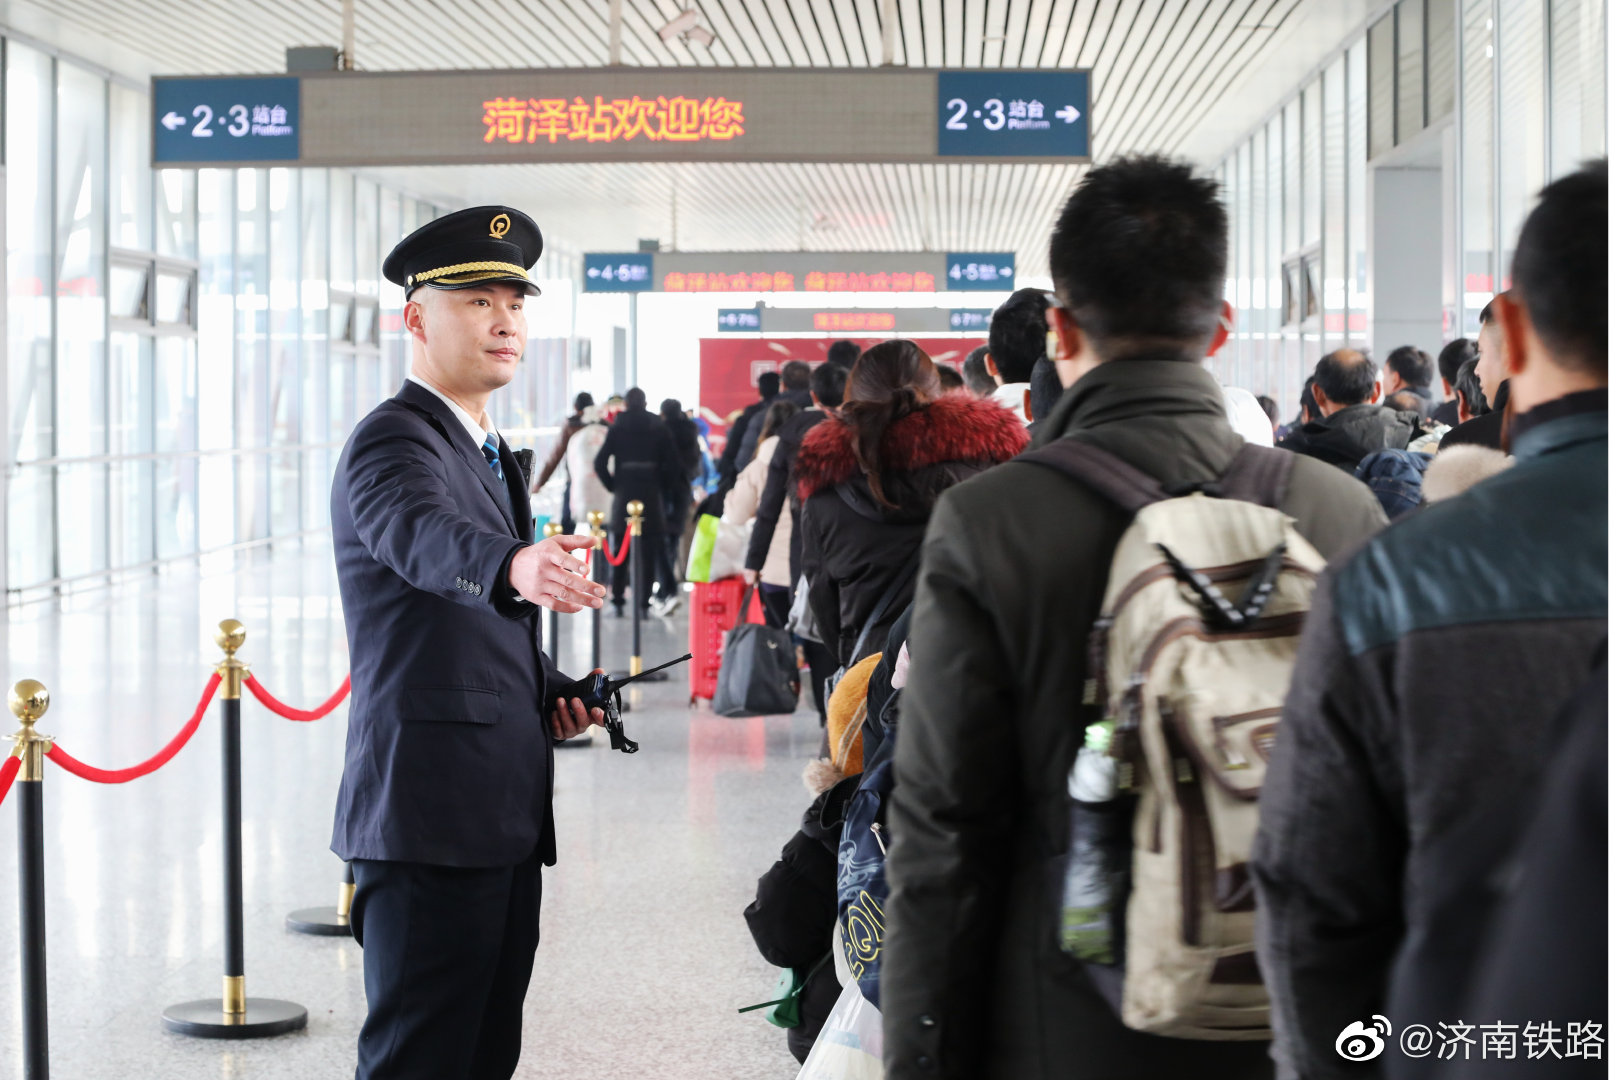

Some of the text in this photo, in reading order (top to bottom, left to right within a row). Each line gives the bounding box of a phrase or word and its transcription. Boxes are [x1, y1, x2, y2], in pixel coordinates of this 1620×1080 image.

[252, 105, 288, 125] 站台
[1008, 99, 1045, 119] 站台
[482, 96, 745, 143] 菏泽站欢迎您
